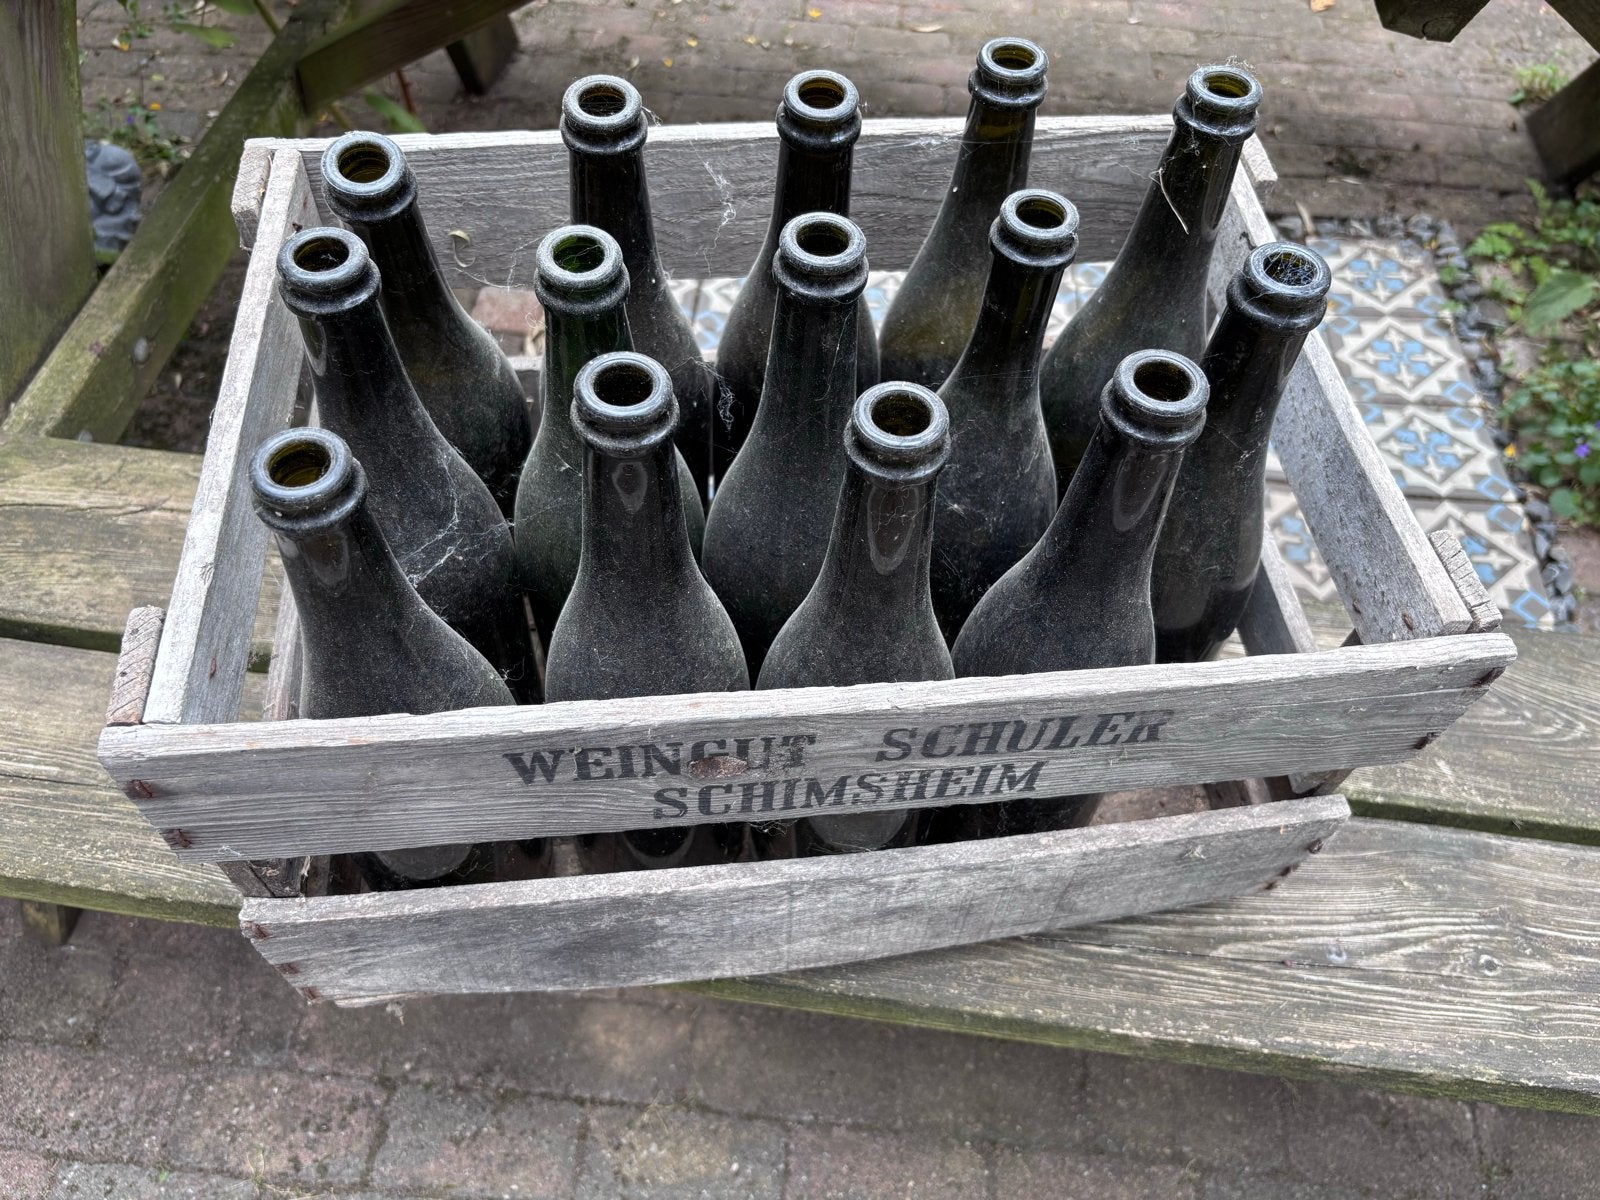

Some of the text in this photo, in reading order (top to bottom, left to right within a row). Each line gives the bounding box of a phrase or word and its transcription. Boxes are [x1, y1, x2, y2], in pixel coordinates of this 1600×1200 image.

[502, 709, 1174, 785] WEINGUT SCHULER
[653, 760, 1048, 819] SCHIMSHEIM
